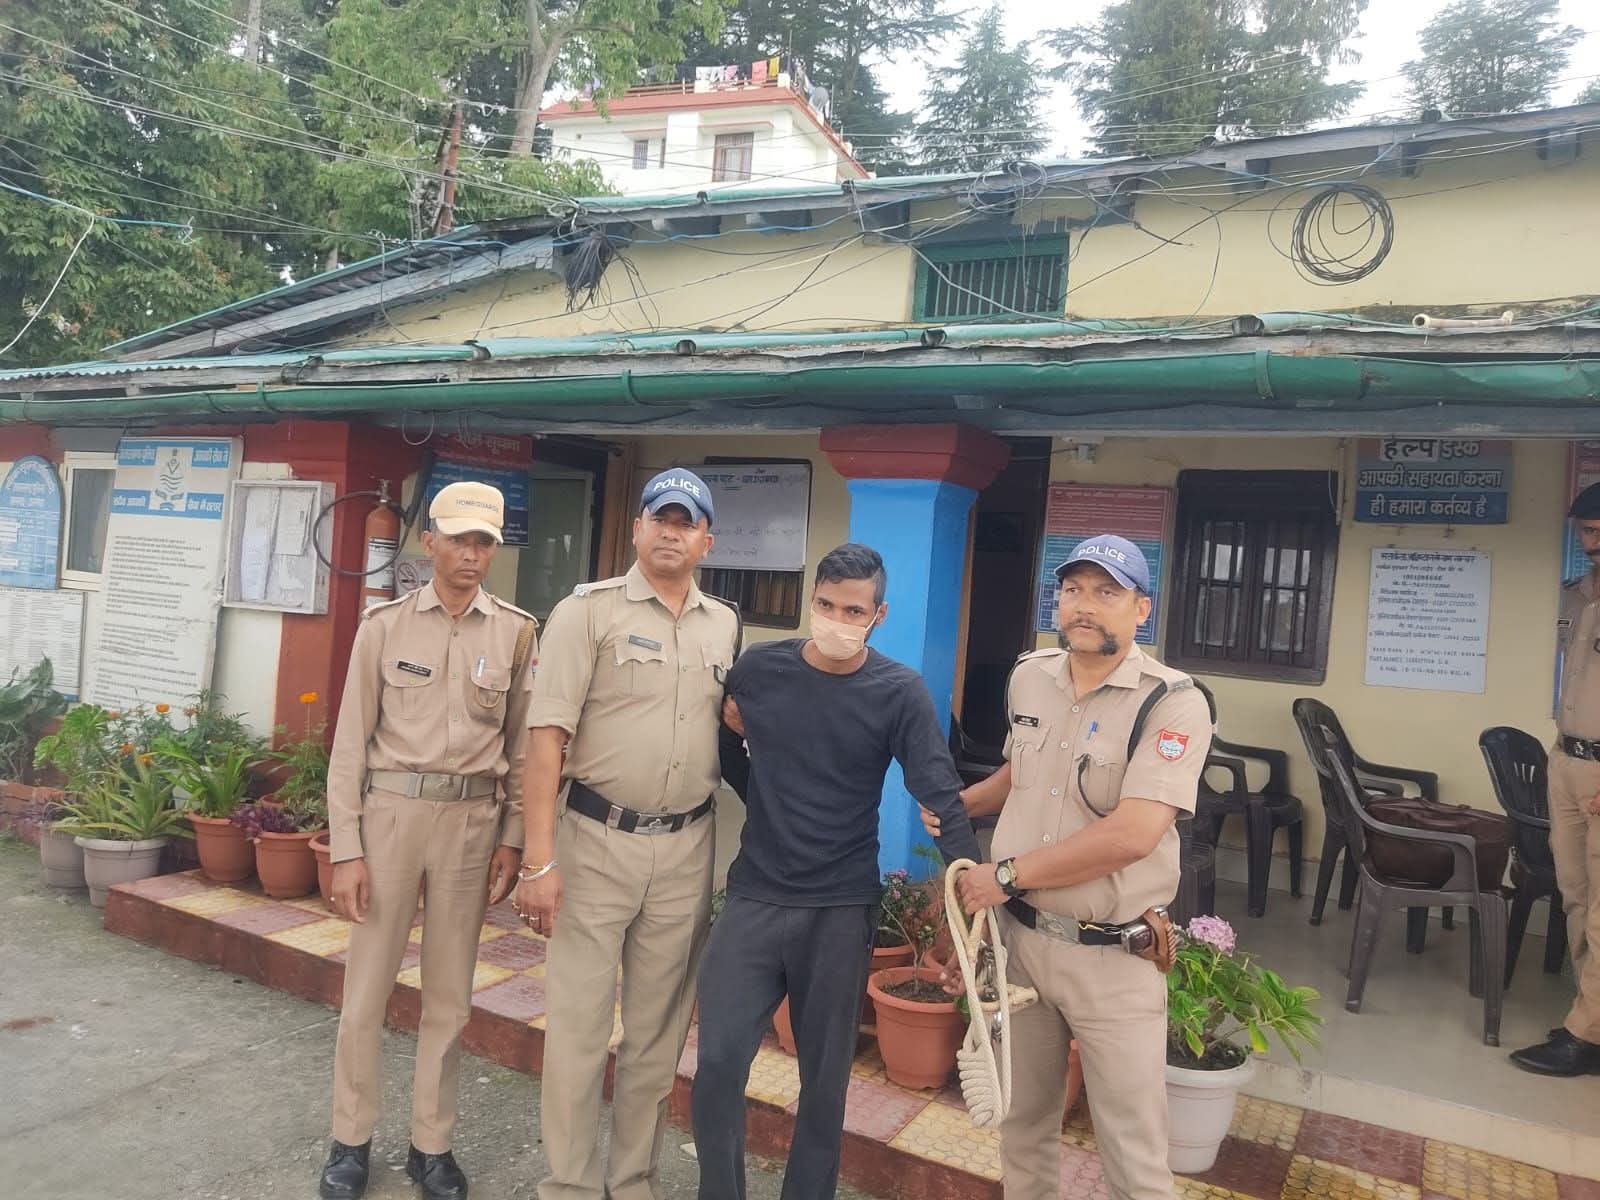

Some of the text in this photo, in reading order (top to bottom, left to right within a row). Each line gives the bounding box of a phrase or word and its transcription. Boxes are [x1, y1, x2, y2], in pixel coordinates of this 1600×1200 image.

[1359, 463, 1503, 489] आपकी सहायता करना
[653, 477, 701, 498] POLICE
[1369, 493, 1385, 516] ही
[1388, 499, 1427, 516] हमारा
[1430, 494, 1473, 517] कर्तव्य
[1078, 545, 1126, 563] POLICE
